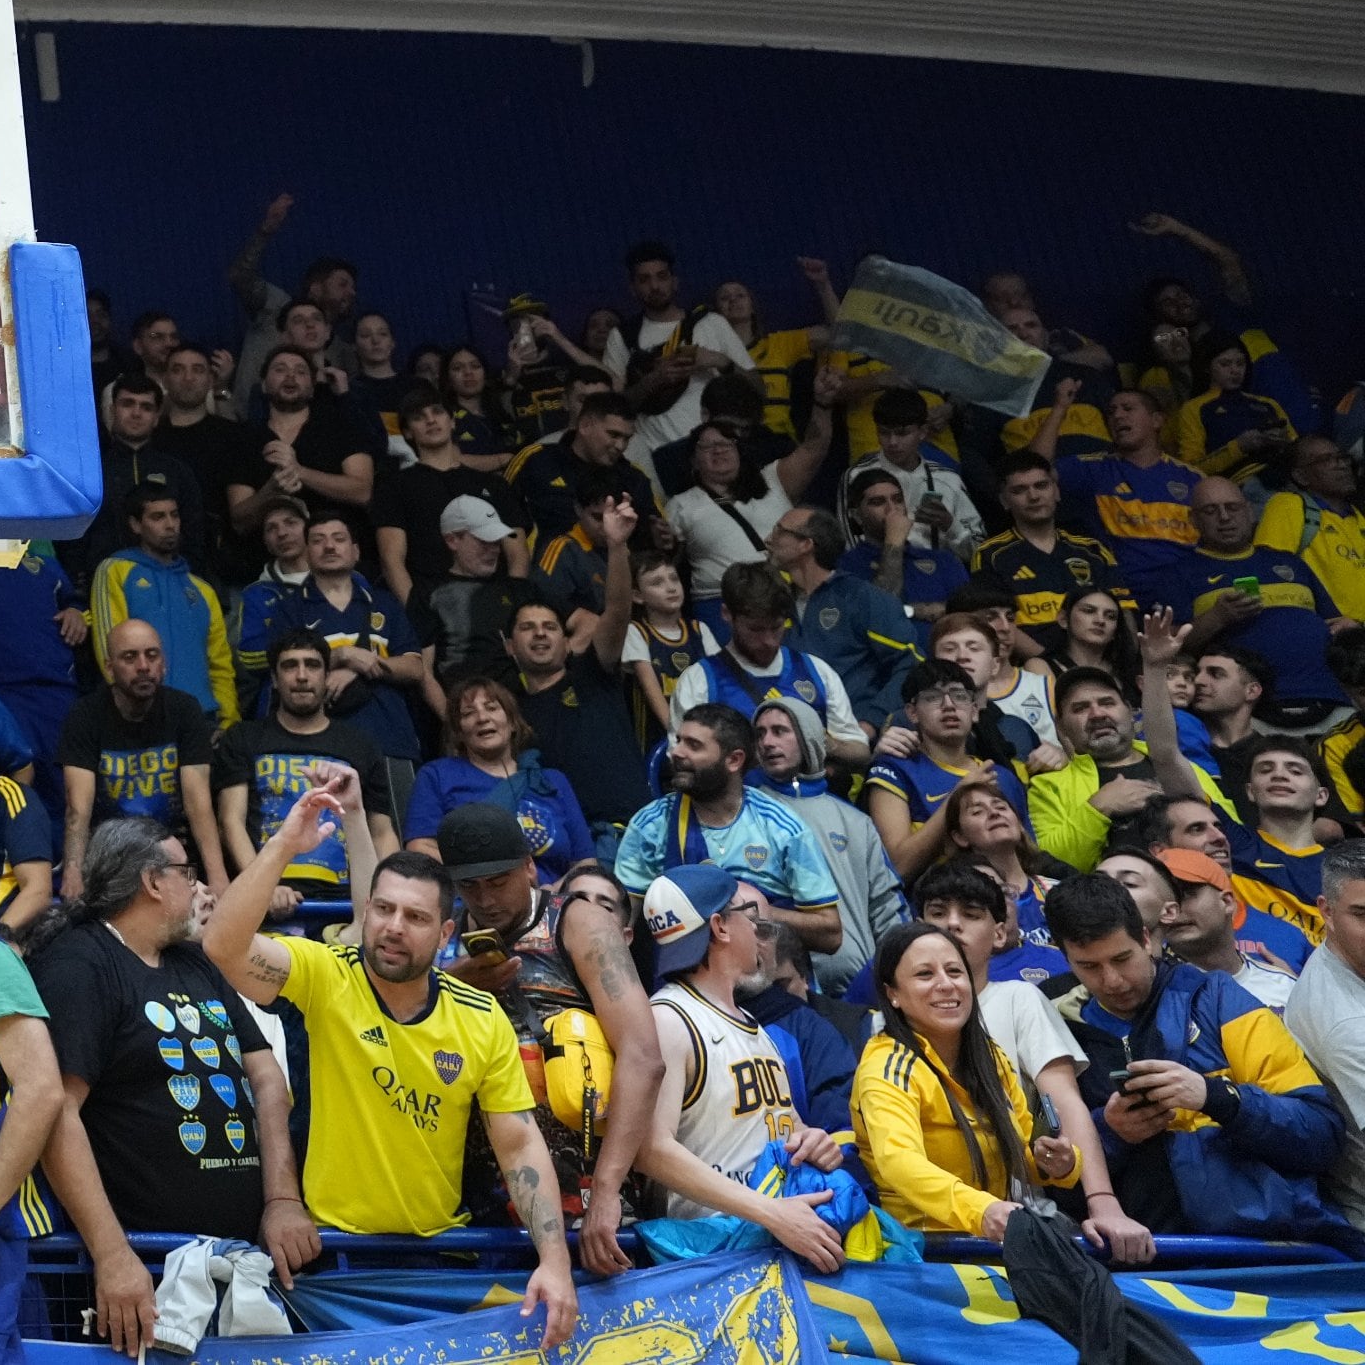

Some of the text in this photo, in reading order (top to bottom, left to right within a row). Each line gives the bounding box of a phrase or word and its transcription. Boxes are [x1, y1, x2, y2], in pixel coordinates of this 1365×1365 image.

[100, 746, 178, 777] DIEGO
[106, 772, 175, 800] VIVE
[1268, 900, 1327, 933] QAT
[435, 1060, 460, 1072] CABJ
